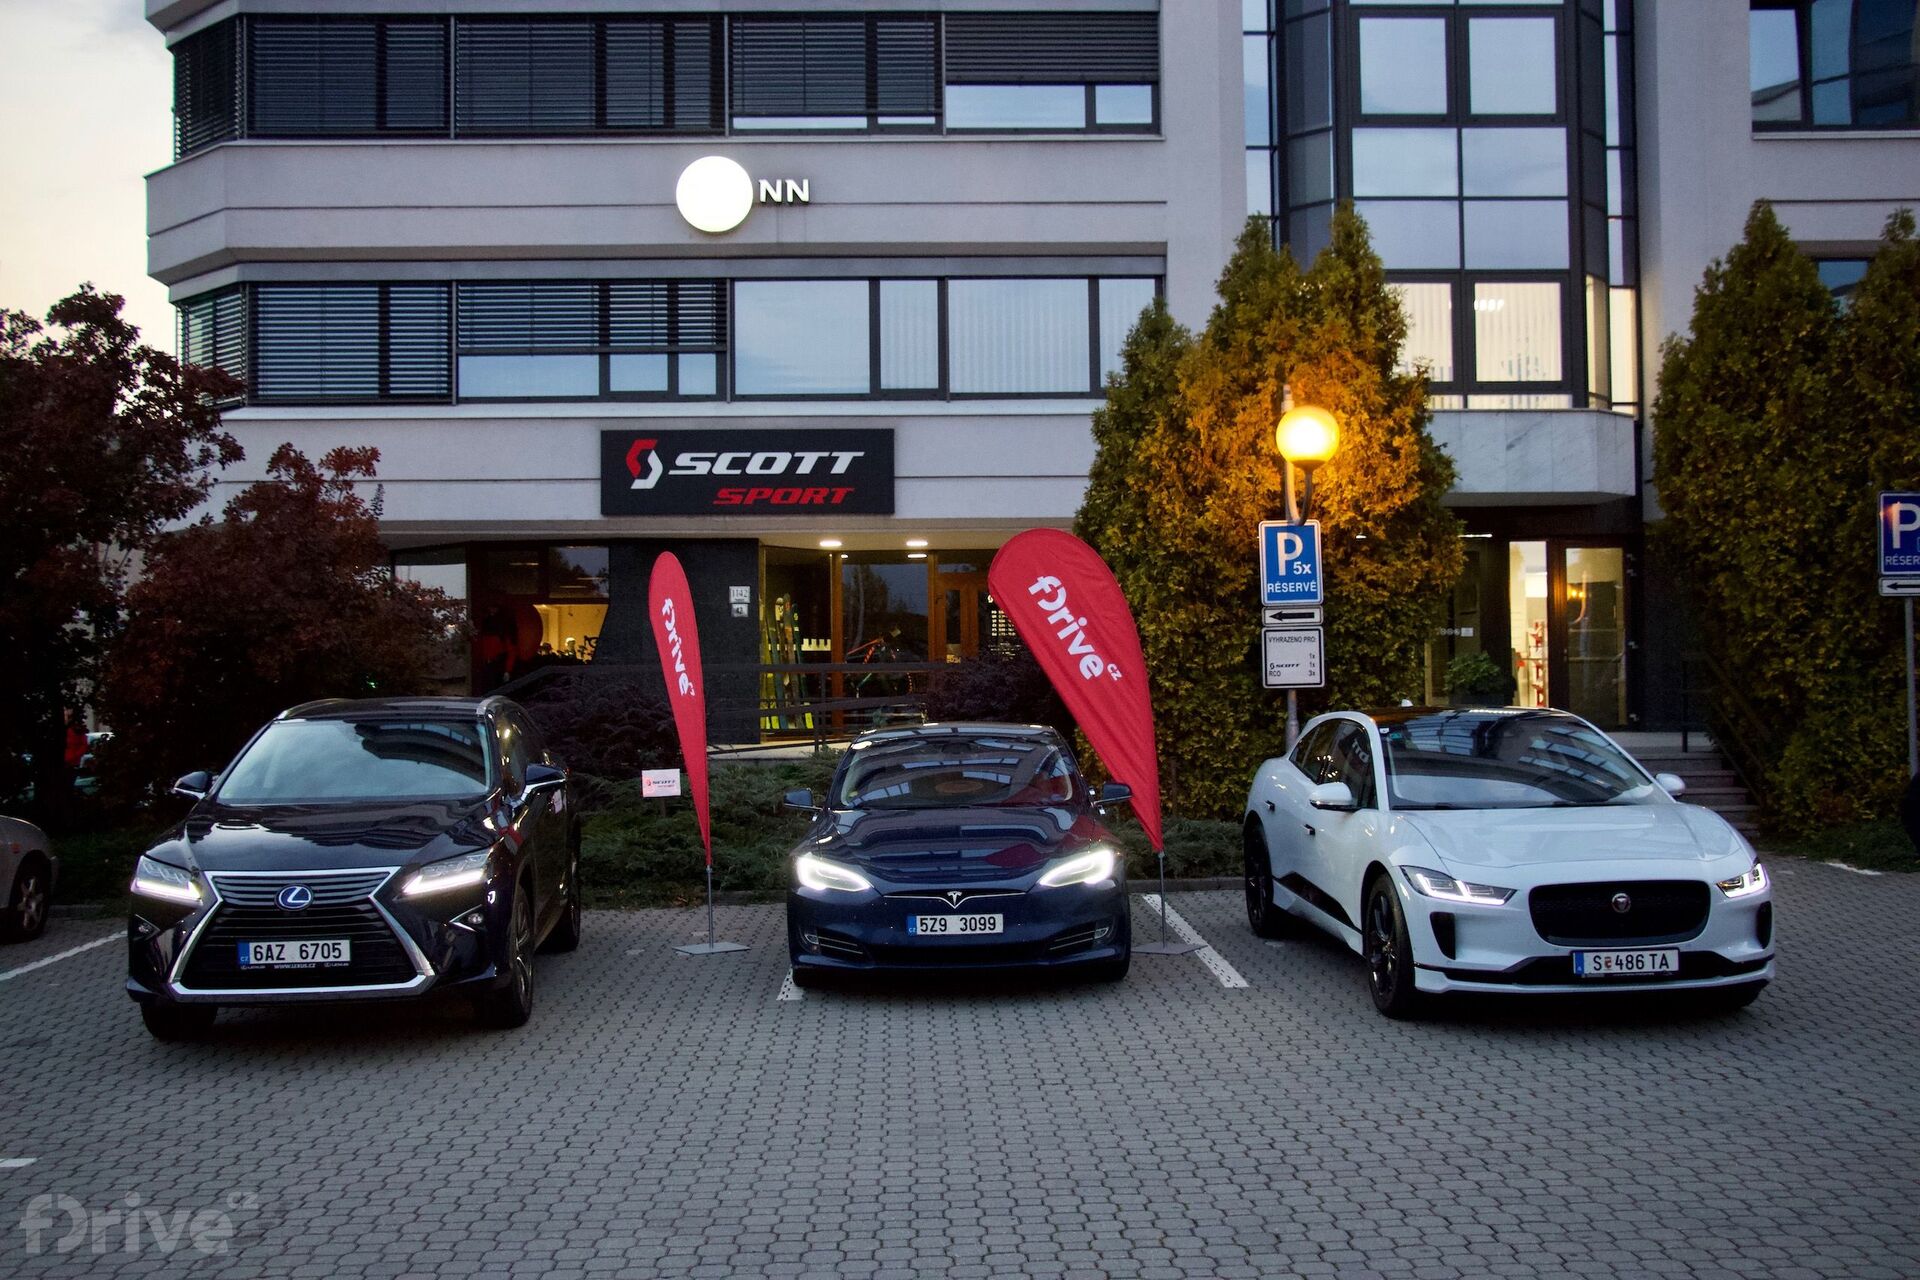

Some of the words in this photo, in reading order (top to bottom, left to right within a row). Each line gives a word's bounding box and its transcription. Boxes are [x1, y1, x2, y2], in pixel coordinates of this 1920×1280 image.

[758, 179, 810, 203] NN
[668, 451, 866, 475] SCOTT
[713, 487, 855, 505] SPORT
[1891, 503, 1920, 549] P
[1277, 532, 1303, 576] P
[1293, 562, 1312, 575] 5x
[1267, 580, 1317, 593] RÉSERVÉ
[919, 917, 948, 932] 5Z9
[959, 916, 997, 932] 3099
[253, 943, 286, 962] 6AZ
[299, 942, 342, 960] 6705
[1615, 953, 1645, 971] 486
[1649, 952, 1670, 970] TA
